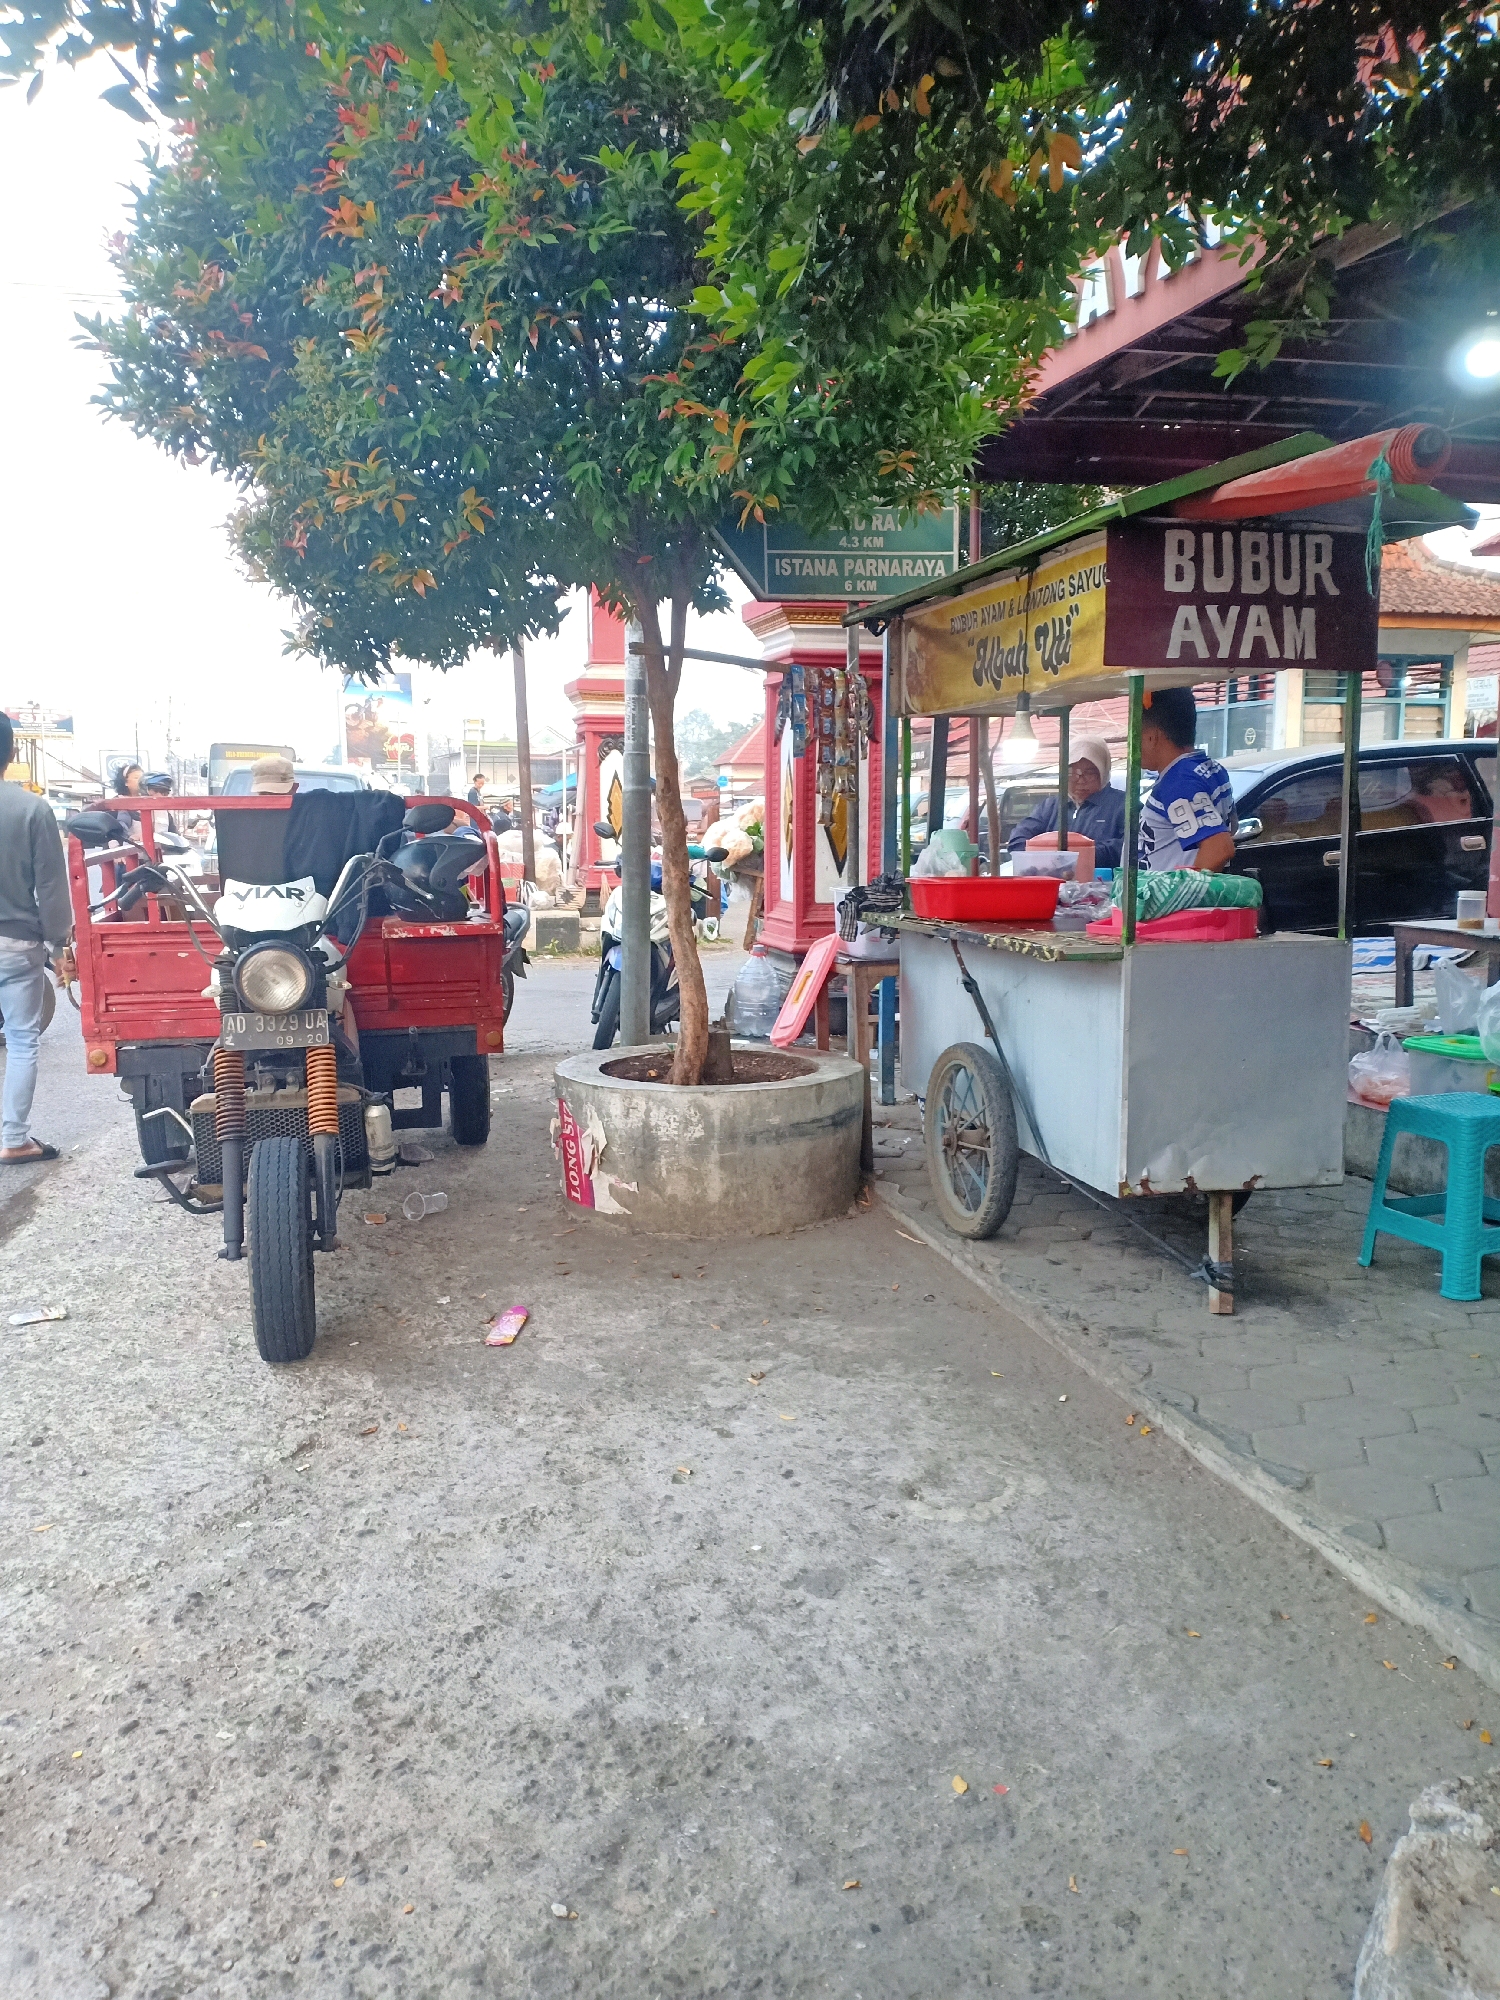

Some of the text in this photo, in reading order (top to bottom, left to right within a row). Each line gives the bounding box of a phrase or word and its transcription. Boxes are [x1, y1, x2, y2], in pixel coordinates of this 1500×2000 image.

[839, 536, 884, 548] 4.3 KM
[775, 558, 946, 577] ISTANA PARNARAYA
[1164, 529, 1341, 596] BUBUR
[845, 580, 877, 592] 6 KM
[950, 610, 979, 635] BUBUR
[980, 600, 1007, 626] AYAM
[1016, 578, 1066, 616] LONTONG
[1166, 604, 1317, 660] AYAM
[1167, 791, 1223, 839] 93
[232, 885, 306, 902] VIAR
[226, 1012, 326, 1034] AD 3329 UA
[565, 1139, 582, 1202] LONG
